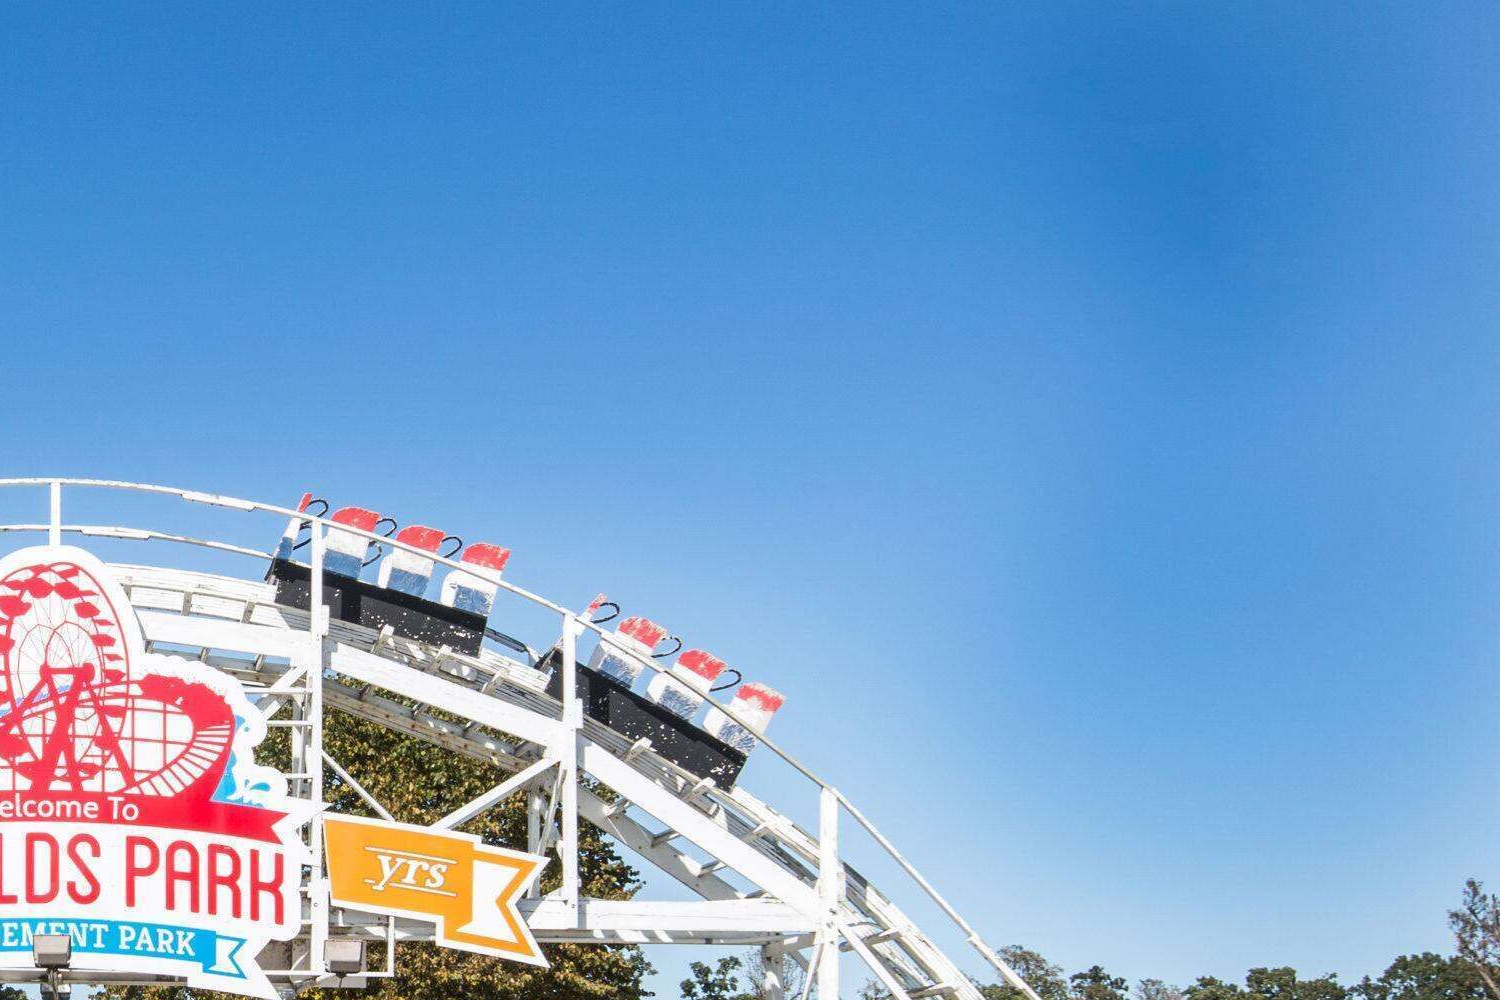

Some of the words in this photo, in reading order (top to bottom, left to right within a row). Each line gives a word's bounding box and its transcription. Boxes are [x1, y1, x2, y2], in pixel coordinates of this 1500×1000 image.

[108, 796, 140, 821] To
[125, 835, 285, 926] PARK
[371, 854, 448, 891] yrs
[118, 923, 197, 957] PARK
